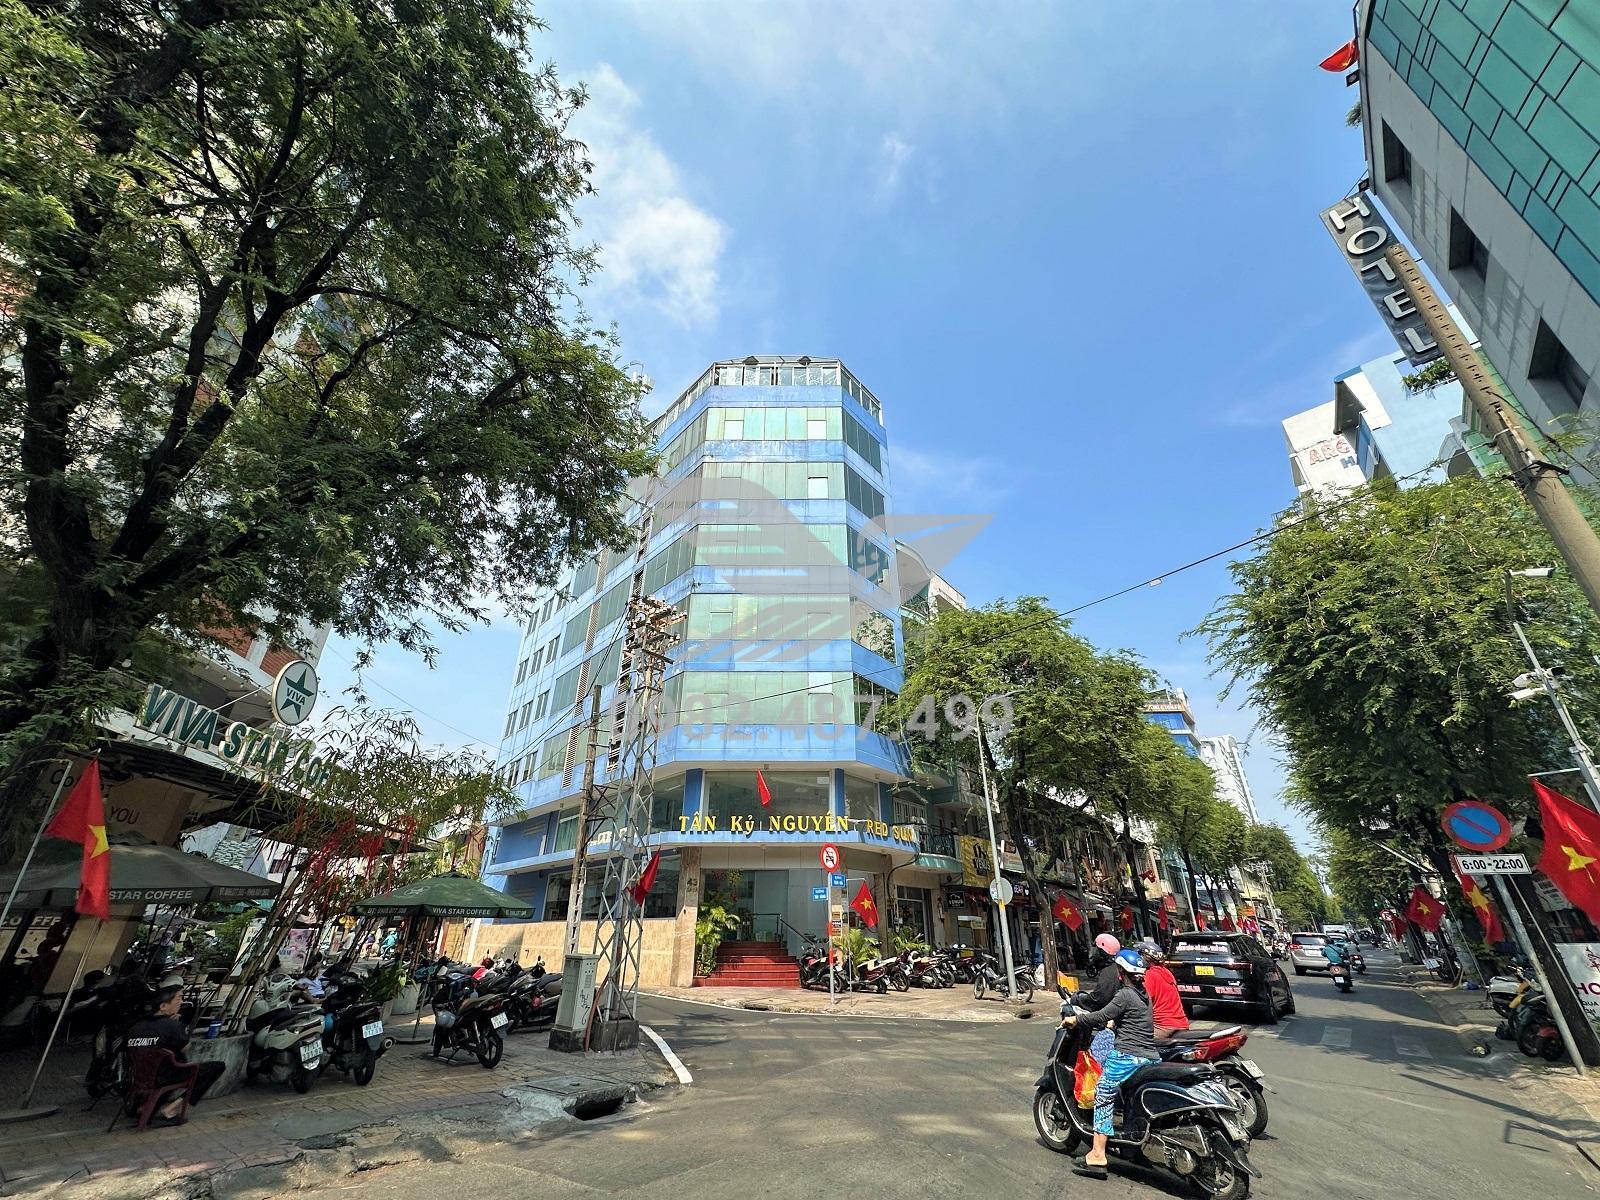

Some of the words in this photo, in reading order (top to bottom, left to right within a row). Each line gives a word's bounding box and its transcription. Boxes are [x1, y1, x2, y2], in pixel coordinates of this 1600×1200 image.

[1329, 196, 1439, 354] HOTEL
[286, 687, 306, 706] VIVA
[141, 683, 220, 750] VIVA
[219, 721, 291, 778] STAR
[679, 811, 717, 832] TÂN
[867, 819, 888, 837] RED
[109, 891, 141, 900] STAR
[145, 890, 193, 900] COFFEE
[127, 1036, 160, 1047] SECURITY
